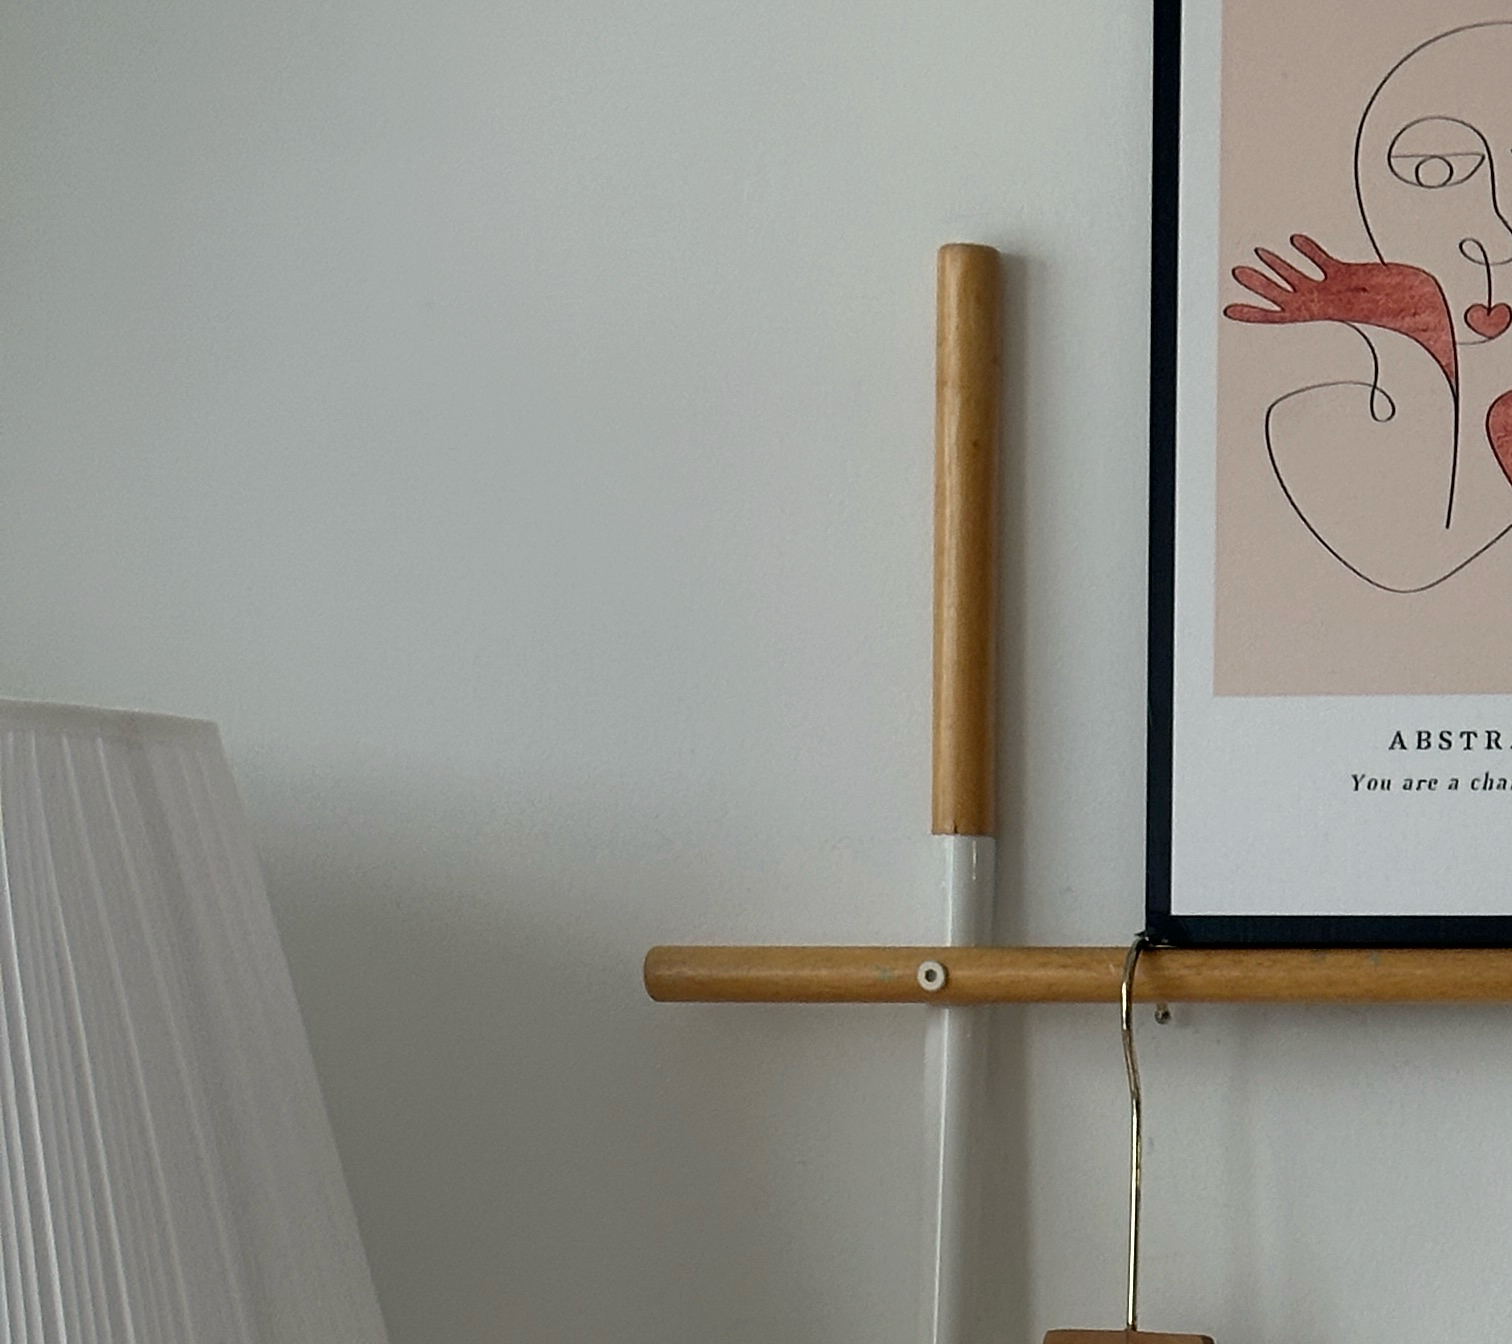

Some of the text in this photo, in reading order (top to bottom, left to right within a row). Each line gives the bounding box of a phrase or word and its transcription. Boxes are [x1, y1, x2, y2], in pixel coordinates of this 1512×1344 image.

[1351, 773, 1391, 792] You
[1402, 774, 1438, 792] are
[1447, 775, 1459, 791] a
